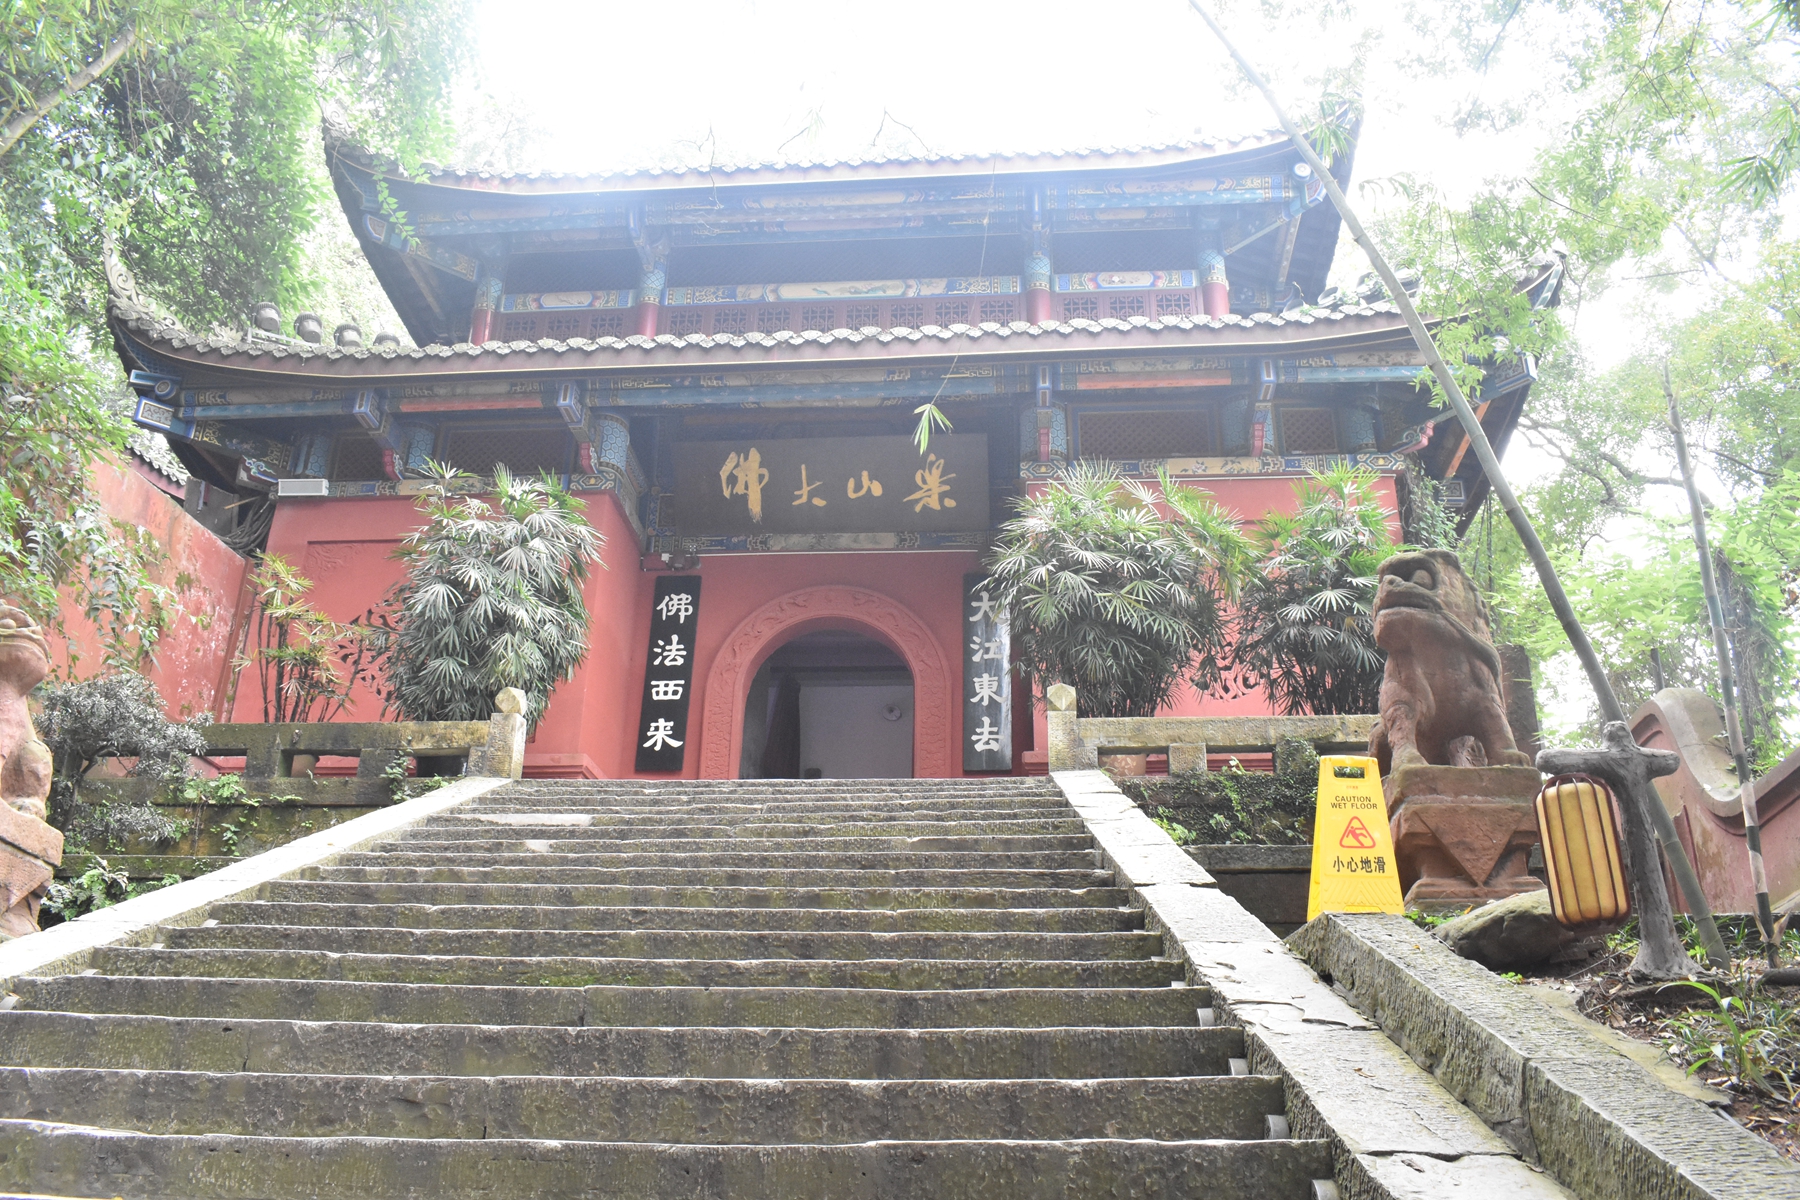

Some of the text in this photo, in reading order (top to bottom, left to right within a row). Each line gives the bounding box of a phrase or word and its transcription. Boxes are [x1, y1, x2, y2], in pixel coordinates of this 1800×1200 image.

[1334, 795, 1372, 803] CAUTION
[1330, 802, 1378, 810] WET FLOOR
[1332, 855, 1386, 874] 小心地滑
